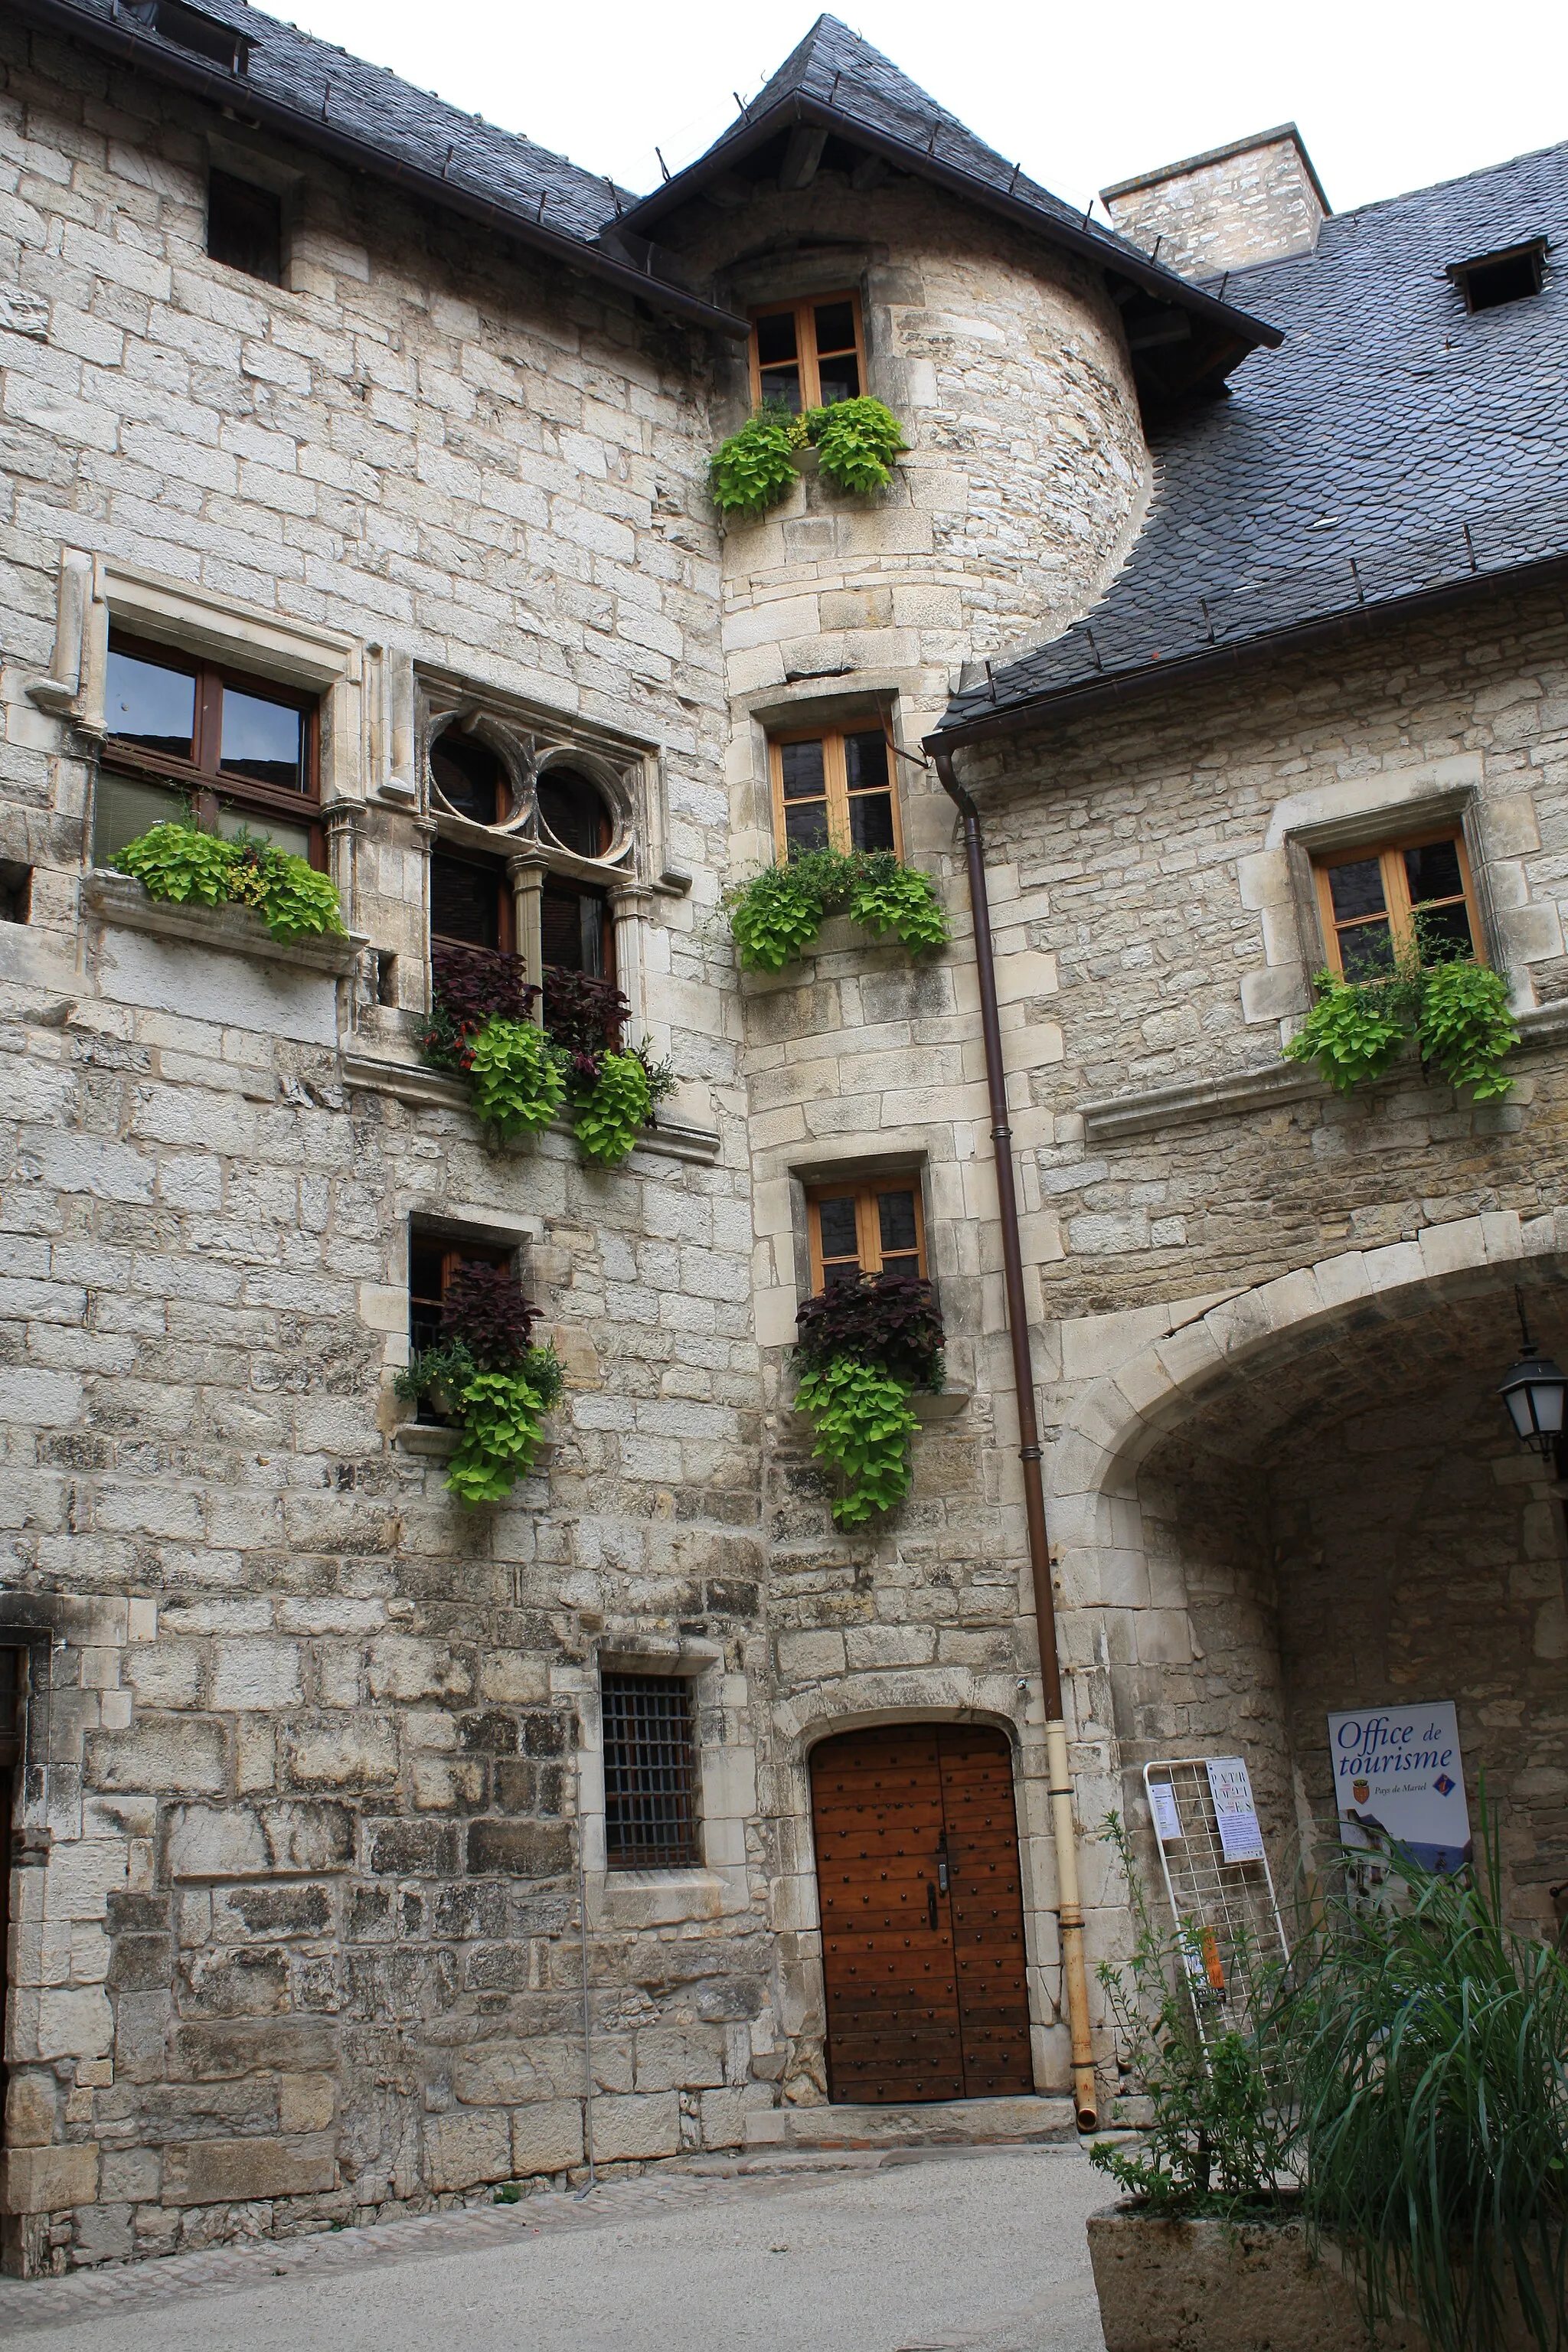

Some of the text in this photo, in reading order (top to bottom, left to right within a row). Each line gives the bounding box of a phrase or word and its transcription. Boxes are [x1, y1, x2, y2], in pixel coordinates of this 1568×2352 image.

[1338, 1717, 1442, 1756] Office de
[1339, 1746, 1452, 1776] tourisme
[1374, 1782, 1427, 1795] Pays de Martel
